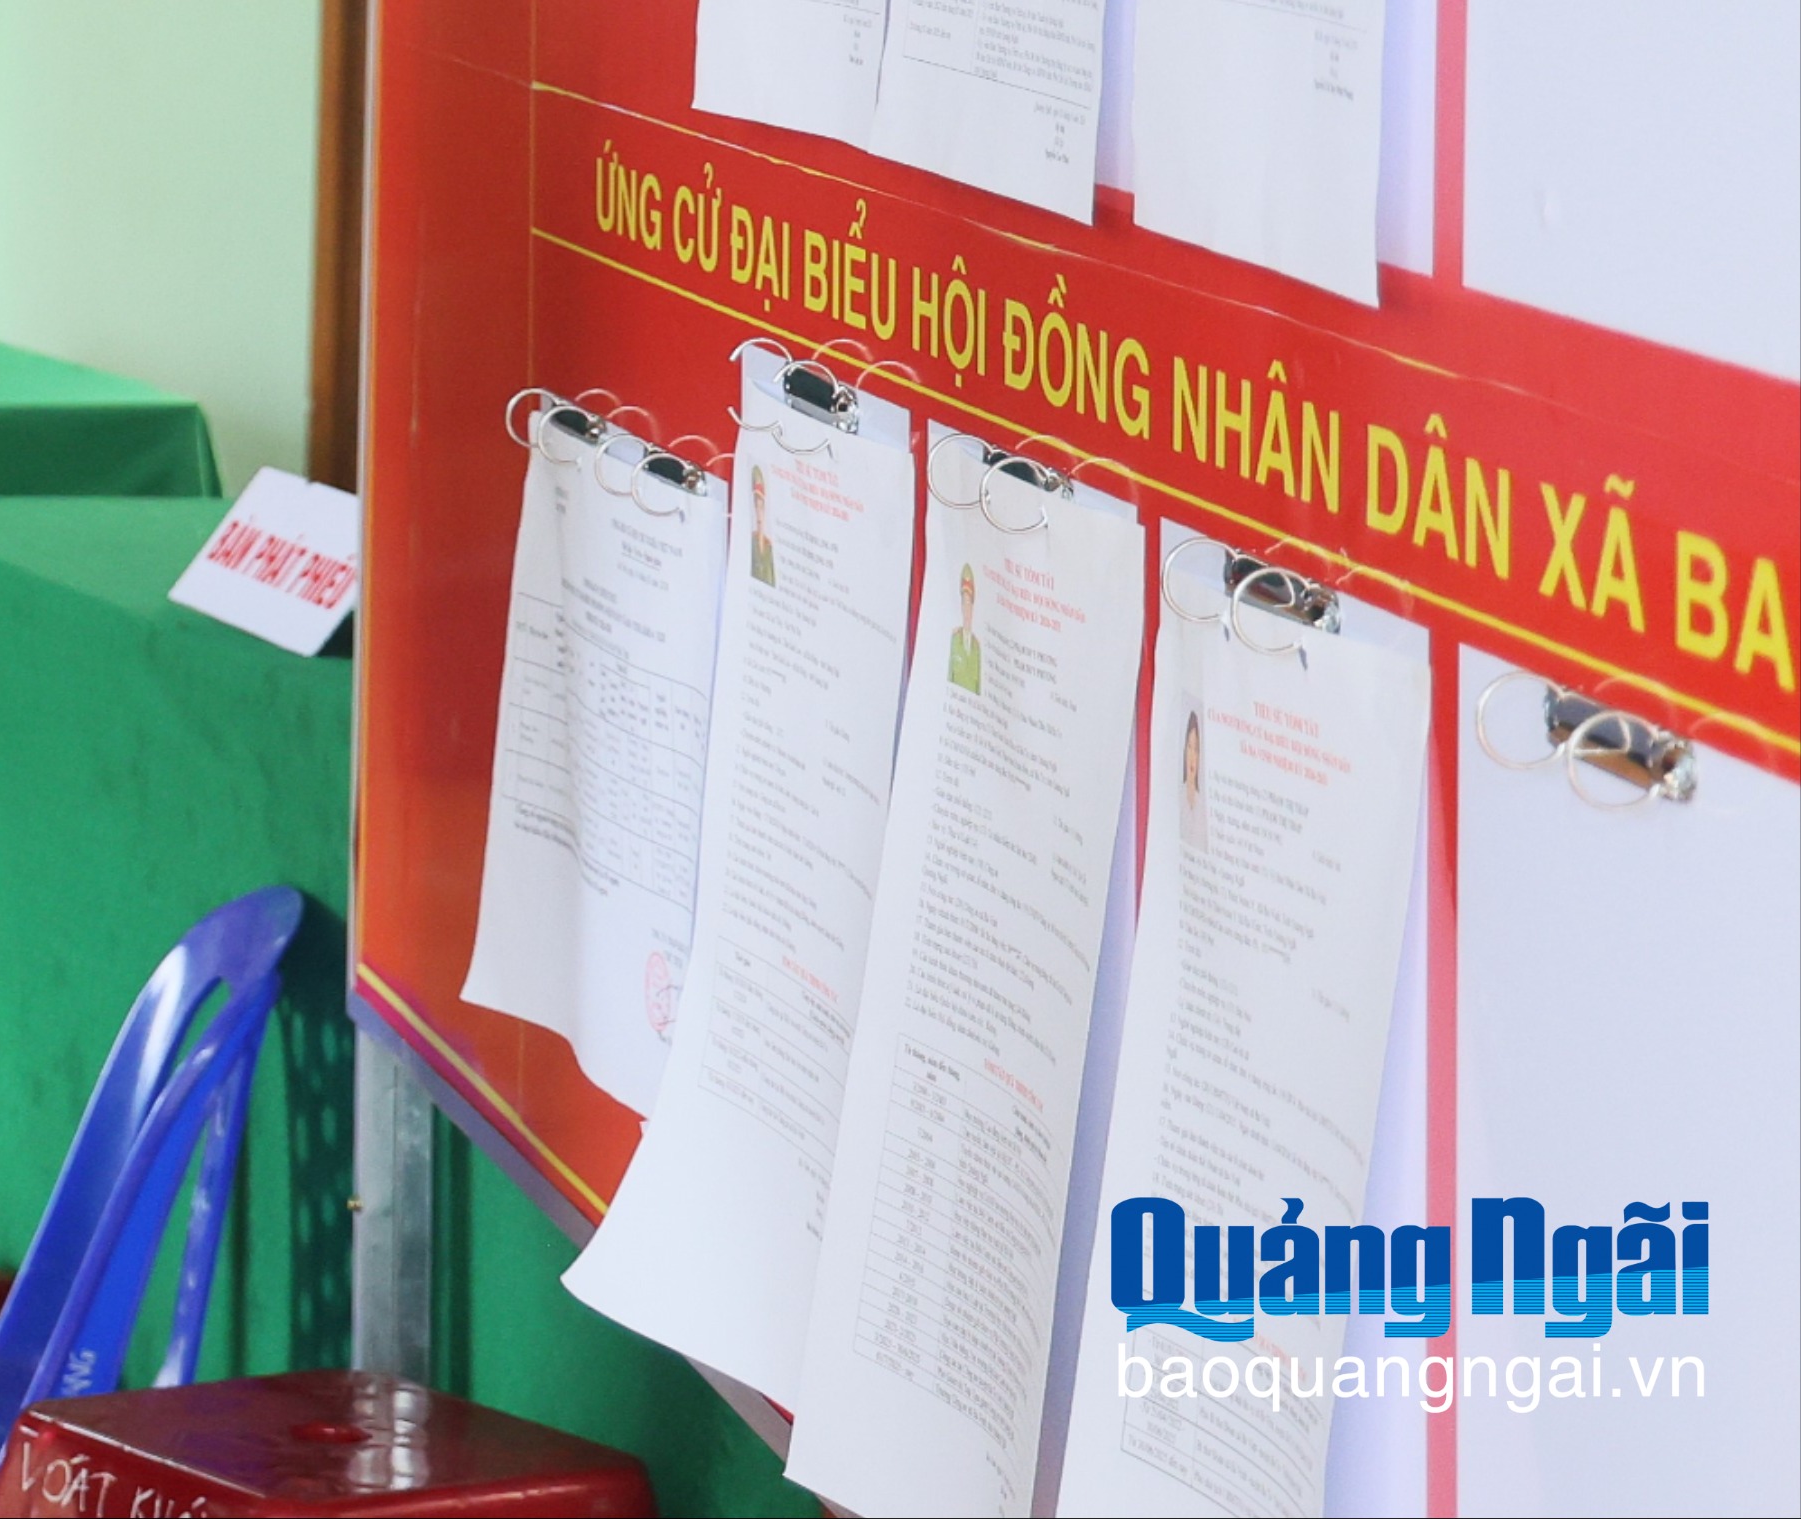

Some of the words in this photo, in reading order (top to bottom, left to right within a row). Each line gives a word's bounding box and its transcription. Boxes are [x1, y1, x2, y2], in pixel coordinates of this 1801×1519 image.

[595, 139, 663, 251] ỨNG
[672, 162, 723, 273] CỬ
[729, 204, 791, 313] ĐẠI
[802, 198, 898, 341] BIỂU
[911, 254, 987, 389] HỘI
[1002, 272, 1151, 441] ĐỒNG
[1172, 355, 1341, 515] NHÂN
[1365, 412, 1511, 580] DÂN
[1538, 473, 1645, 634] XÃ
[1675, 529, 1796, 693] BA
